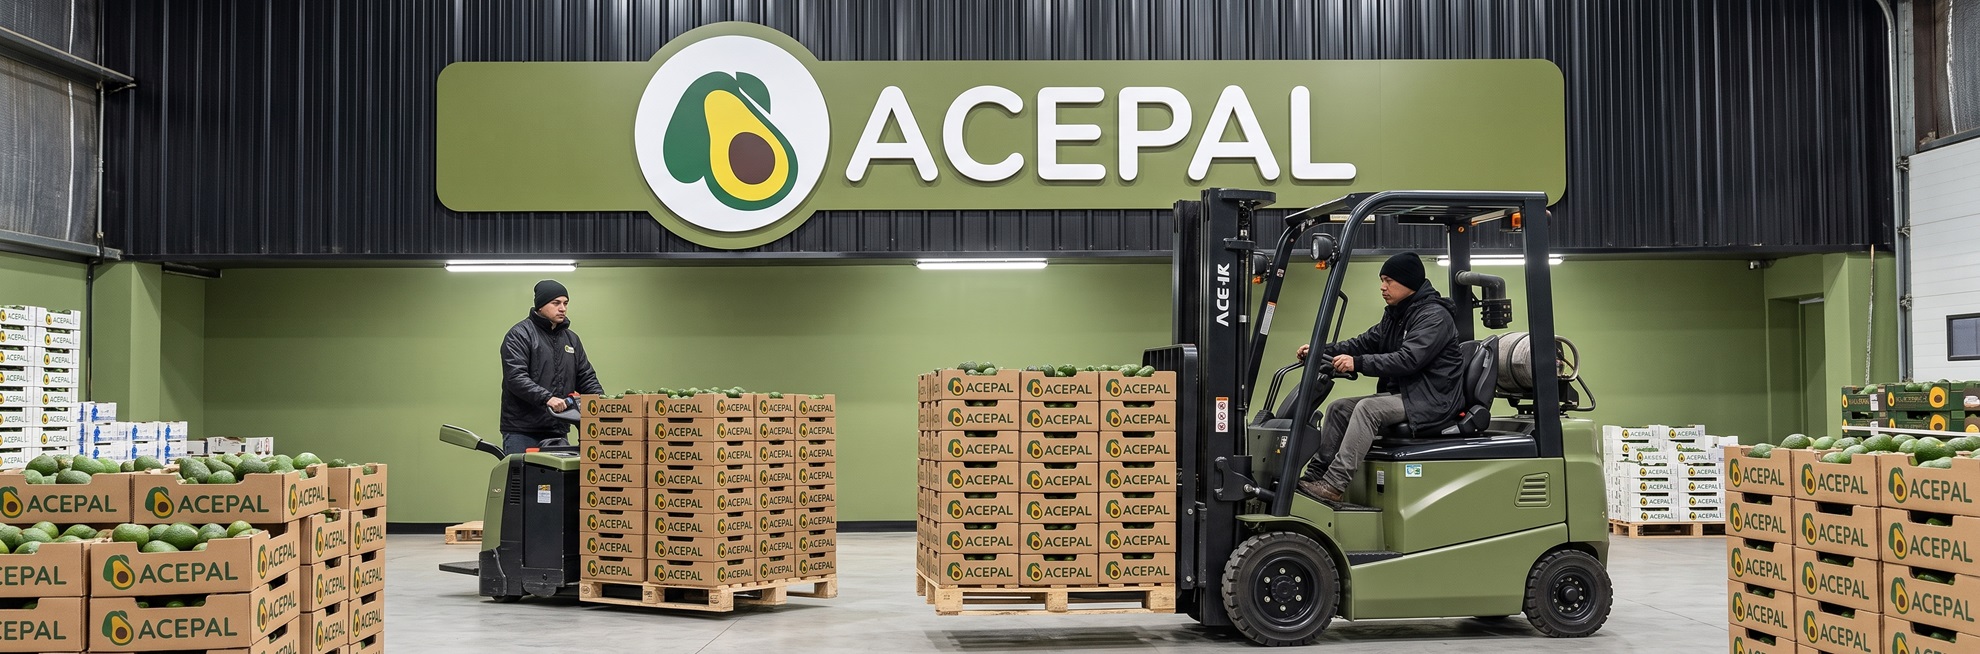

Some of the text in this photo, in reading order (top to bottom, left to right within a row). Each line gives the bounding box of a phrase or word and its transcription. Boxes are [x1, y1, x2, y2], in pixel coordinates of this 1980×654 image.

[845, 84, 1356, 182] ACEPAL
[966, 383, 1013, 392] ACEPAL
[1045, 385, 1092, 394] ACEPAL
[1124, 384, 1170, 393] ACEPAL
[599, 404, 632, 413] ACEPAL
[668, 404, 702, 413] ACEPAL
[727, 403, 752, 413] ACEPAL
[769, 403, 793, 413] ACEPAL
[966, 414, 1013, 423] ACEPAL
[1045, 415, 1092, 424] ACEPAL
[1124, 414, 1170, 424] ACEPAL
[600, 427, 632, 436] ACEPAL
[668, 428, 702, 436] ACEPAL
[727, 427, 752, 435] ACEPAL
[769, 426, 793, 435] ACEPAL
[769, 449, 793, 459] ACEPAL
[809, 449, 833, 457] ACEPAL
[966, 444, 1013, 454] ACEPAL
[1045, 445, 1092, 455] ACEPAL
[1124, 445, 1170, 454] ACEPAL
[599, 450, 632, 459] ACEPAL
[668, 452, 702, 460] ACEPAL
[727, 451, 752, 459] ACEPAL
[599, 473, 632, 482] ACEPAL
[668, 475, 702, 484] ACEPAL
[727, 474, 752, 483] ACEPAL
[769, 472, 793, 482] ACEPAL
[966, 475, 1013, 485] ACEPAL
[1045, 476, 1092, 485] ACEPAL
[1123, 475, 1170, 484] ACEPAL
[1743, 467, 1784, 485] ACEPAL
[1818, 473, 1868, 494] ACEPAL
[299, 486, 325, 506] ACEPAL
[362, 483, 384, 500] ACEPAL
[1910, 479, 1972, 503] ACEPAL
[599, 497, 632, 506] ACEPAL
[727, 498, 752, 507] ACEPAL
[769, 495, 793, 505] ACEPAL
[809, 494, 834, 502] ACEPAL
[27, 495, 117, 512] ACEPAL
[178, 495, 269, 513] ACEPAL
[668, 499, 702, 508] ACEPAL
[965, 506, 1013, 515] ACEPAL
[1045, 506, 1092, 516] ACEPAL
[1123, 505, 1170, 514] ACEPAL
[599, 520, 632, 529] ACEPAL
[769, 518, 793, 528] ACEPAL
[809, 516, 834, 525] ACEPAL
[1744, 513, 1786, 533] ACEPAL
[668, 522, 702, 532] ACEPAL
[727, 521, 752, 531] ACEPAL
[362, 526, 383, 542] ACEPAL
[1819, 524, 1868, 547] ACEPAL
[325, 530, 346, 549] ACEPAL
[809, 539, 834, 548] ACEPAL
[965, 536, 1013, 546] ACEPAL
[1044, 537, 1092, 547] ACEPAL
[1123, 536, 1170, 545] ACEPAL
[599, 543, 632, 552] ACEPAL
[668, 546, 703, 556] ACEPAL
[727, 545, 752, 554] ACEPAL
[769, 541, 793, 551] ACEPAL
[1910, 535, 1973, 563] ACEPAL
[269, 541, 296, 567] ACEPAL
[599, 566, 632, 576] ACEPAL
[769, 564, 793, 574] ACEPAL
[809, 562, 834, 571] ACEPAL
[1123, 566, 1170, 576] ACEPAL
[1745, 558, 1786, 581] ACEPAL
[139, 562, 238, 583] ACEPAL
[362, 568, 382, 585] ACEPAL
[668, 570, 702, 580] ACEPAL
[727, 569, 752, 578] ACEPAL
[965, 567, 1013, 577] ACEPAL
[1045, 567, 1092, 577] ACEPAL
[325, 577, 345, 595] ACEPAL
[1820, 574, 1869, 600] ACEPAL
[269, 591, 296, 621] ACEPAL
[1912, 592, 1974, 622] ACEPAL
[361, 609, 381, 630] ACEPAL
[1746, 603, 1787, 629] ACEPAL
[138, 617, 237, 639] ACEPAL
[324, 621, 345, 643] ACEPAL
[1820, 624, 1871, 654] ACEPAL
